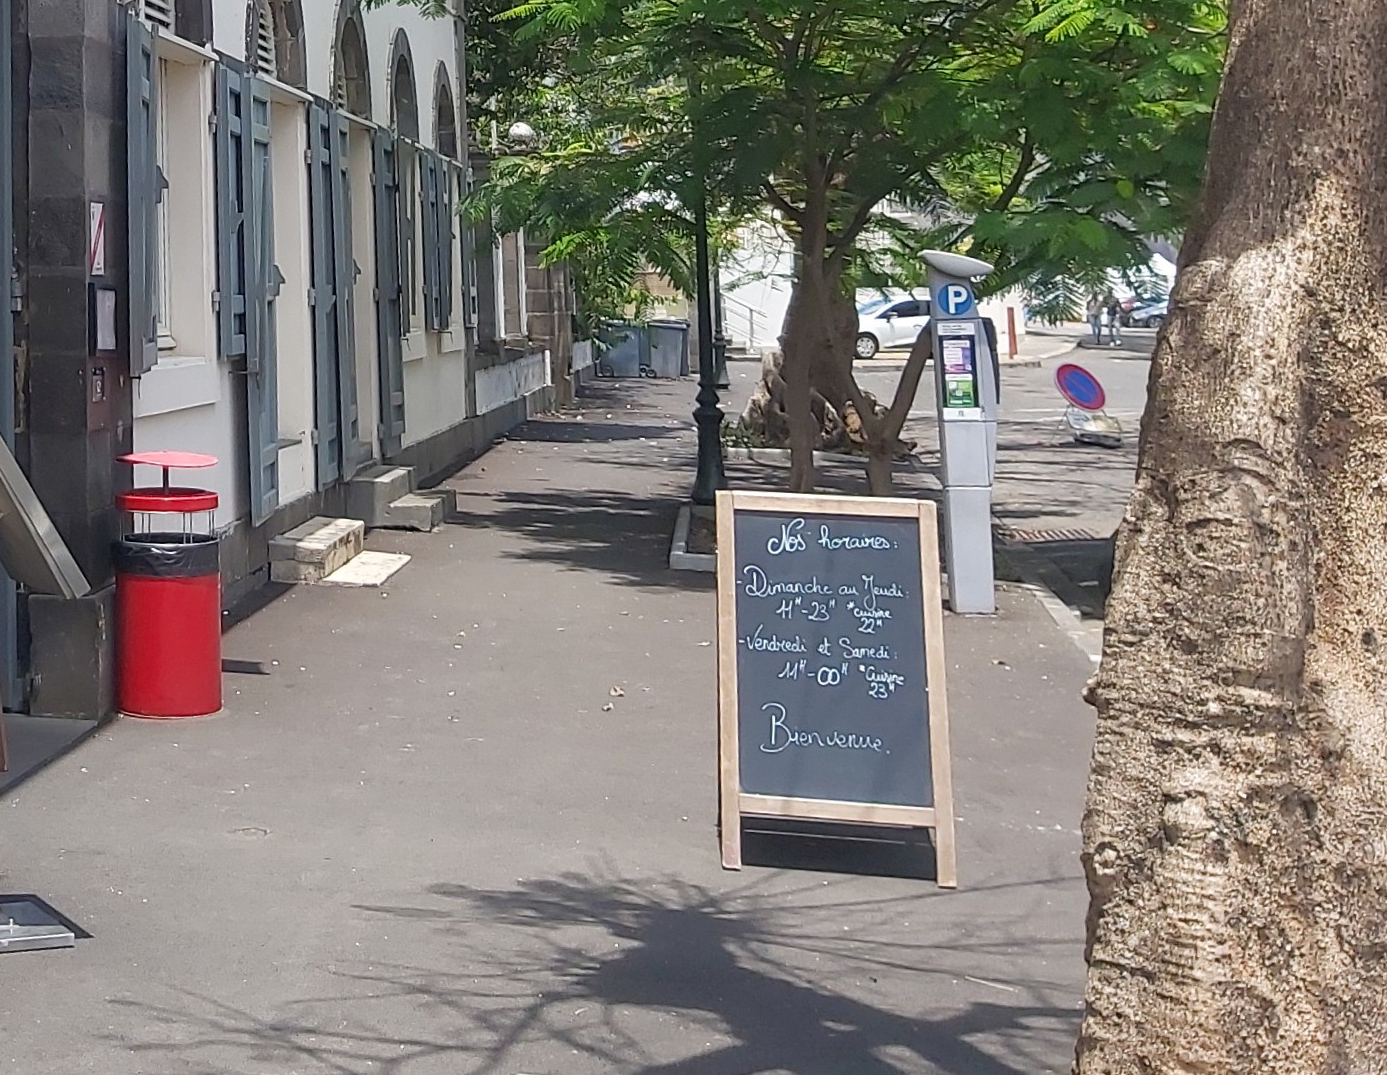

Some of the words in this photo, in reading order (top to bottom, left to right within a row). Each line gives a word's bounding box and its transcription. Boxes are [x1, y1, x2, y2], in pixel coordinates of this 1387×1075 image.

[947, 284, 968, 315] P
[767, 518, 806, 555] Nos
[839, 584, 859, 596] au
[817, 637, 831, 656] et
